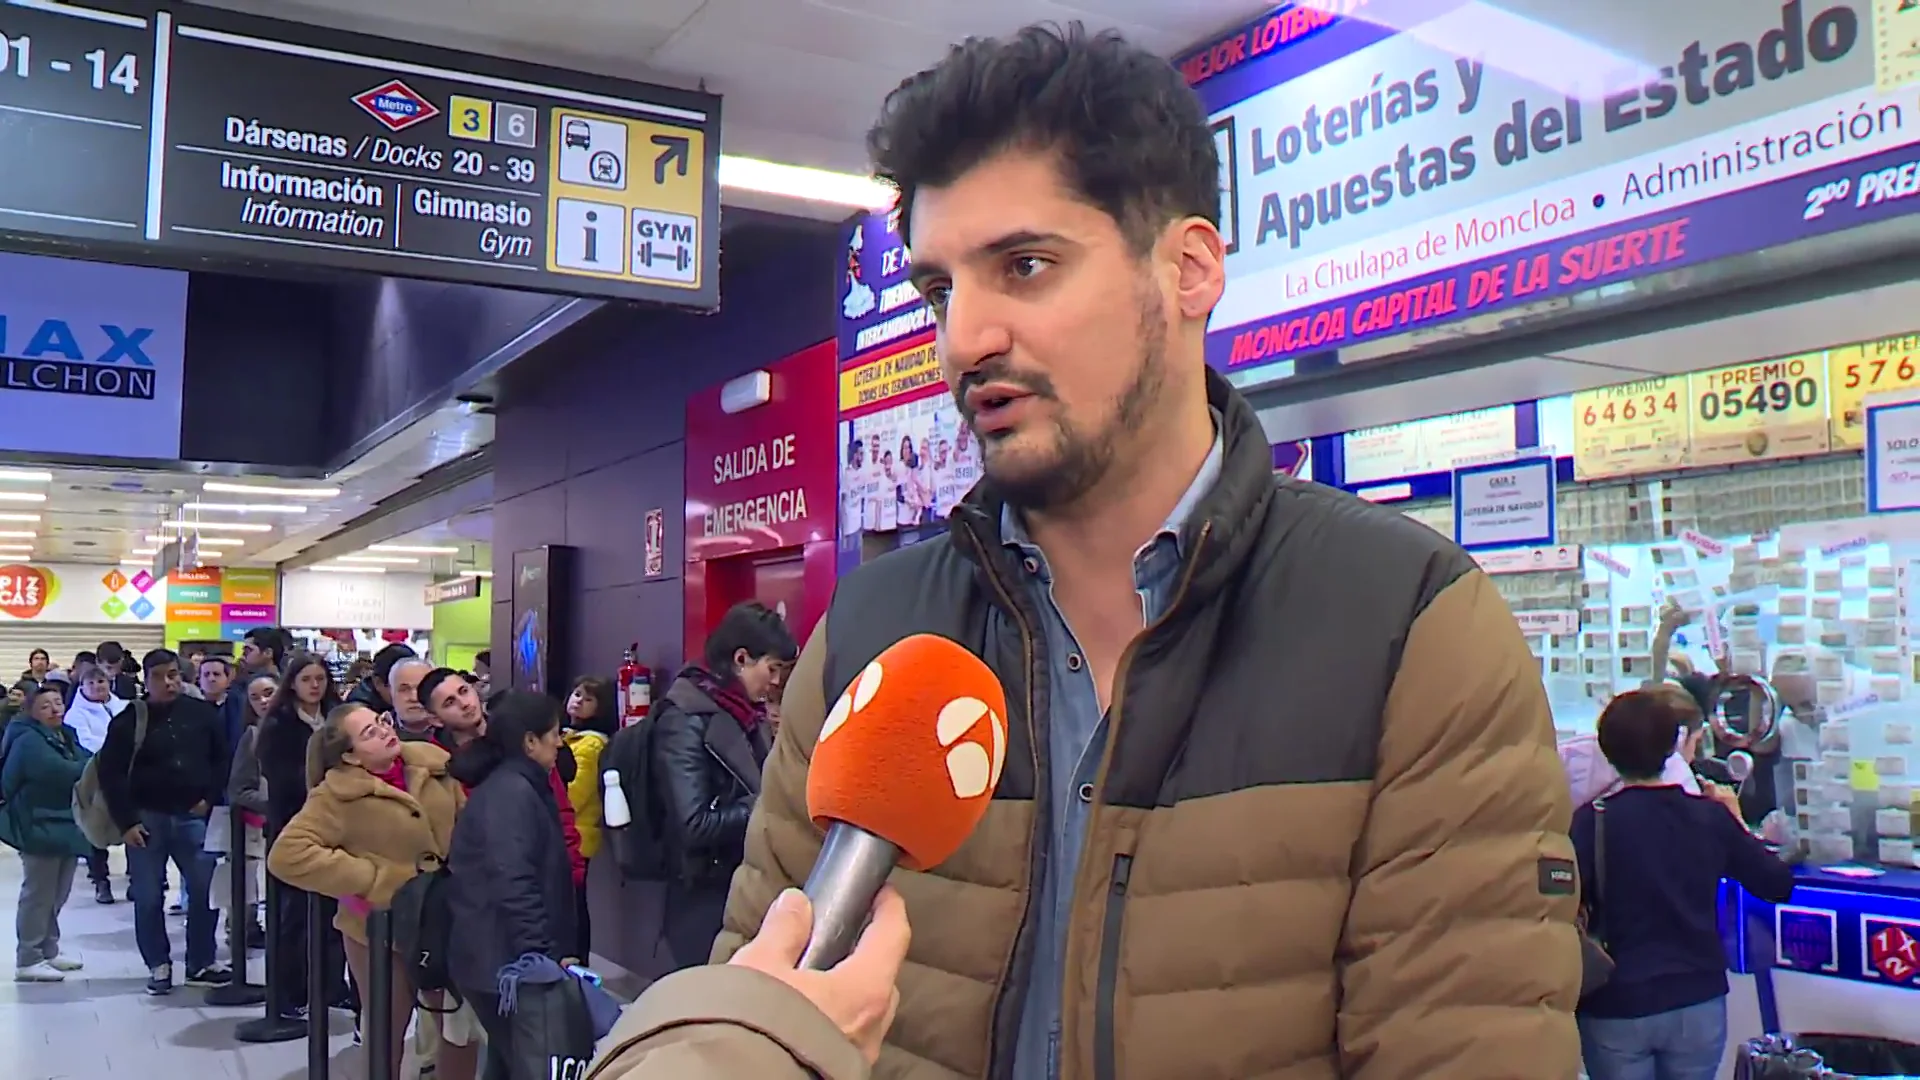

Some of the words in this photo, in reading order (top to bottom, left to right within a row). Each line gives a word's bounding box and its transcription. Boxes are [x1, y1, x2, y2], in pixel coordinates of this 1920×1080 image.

[85, 49, 139, 94] 14
[378, 98, 413, 114] Metro
[463, 108, 480, 132] 3
[508, 113, 525, 137] 6
[1252, 69, 1439, 176] Loterías
[1455, 55, 1484, 114] y
[1256, 136, 1476, 249] Apuestas
[1494, 88, 1582, 167] del
[1603, 0, 1858, 133] Estado
[226, 115, 348, 157] Dársenas
[371, 138, 442, 170] Docks
[452, 150, 482, 176] 20
[506, 158, 535, 183] 39
[221, 162, 383, 207] Información
[1285, 271, 1308, 299] La
[1314, 243, 1409, 290] Chulapa
[1416, 231, 1447, 263] de
[1455, 197, 1575, 249] Moncloa
[1623, 102, 1902, 206] Administración
[241, 197, 384, 238] Information
[415, 188, 531, 227] Gimnasio
[480, 228, 532, 259] Gym
[637, 219, 692, 243] GYM
[1229, 316, 1345, 366] MONCLOA
[1352, 278, 1456, 336] CAPITAL
[1467, 263, 1508, 309] DE
[1512, 253, 1550, 297] LA
[1558, 218, 1690, 286] SUERTE
[1607, 377, 1665, 399] PREMIO
[1722, 359, 1805, 388] PREMIO
[1583, 391, 1678, 426] 64634
[1700, 376, 1817, 421] 05490
[713, 443, 769, 485] SALIDA
[772, 433, 796, 470] DE
[704, 487, 808, 538] EMERGENCIA
